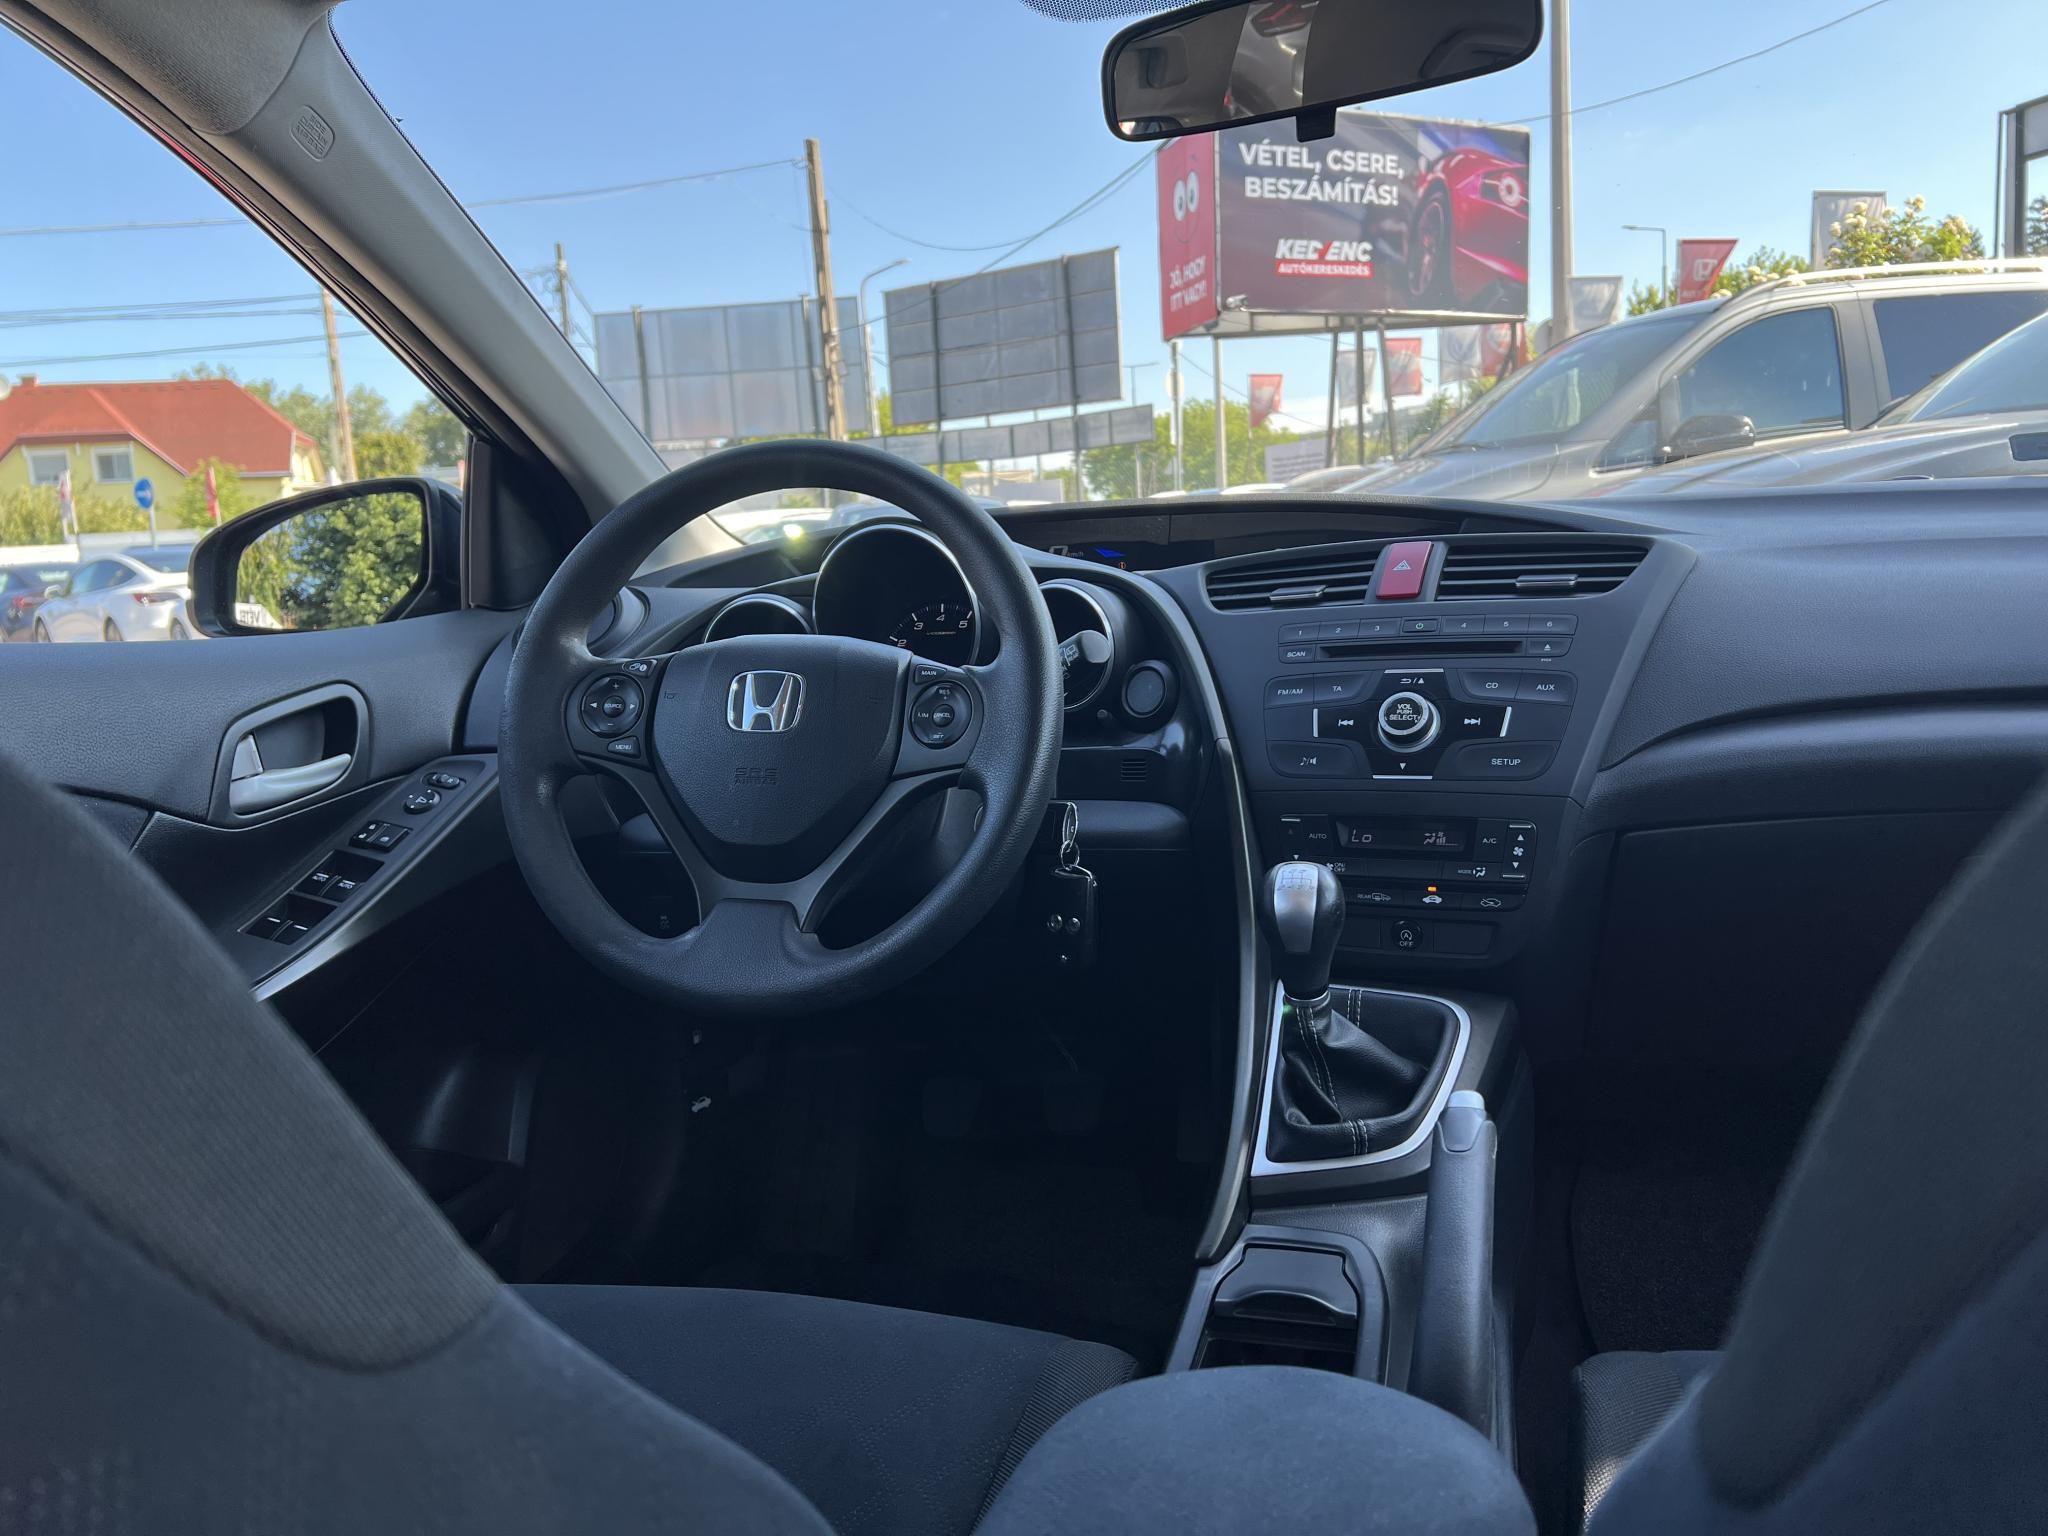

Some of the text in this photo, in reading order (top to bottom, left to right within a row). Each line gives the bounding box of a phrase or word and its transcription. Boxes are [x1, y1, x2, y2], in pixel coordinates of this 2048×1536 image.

[1239, 139, 1404, 180] VÉTEL, CSERE,
[1244, 174, 1399, 206] BESZÁMÍTÁS!
[913, 620, 968, 630] 3 5
[897, 639, 907, 647] 2
[1491, 758, 1521, 766] SETUP
